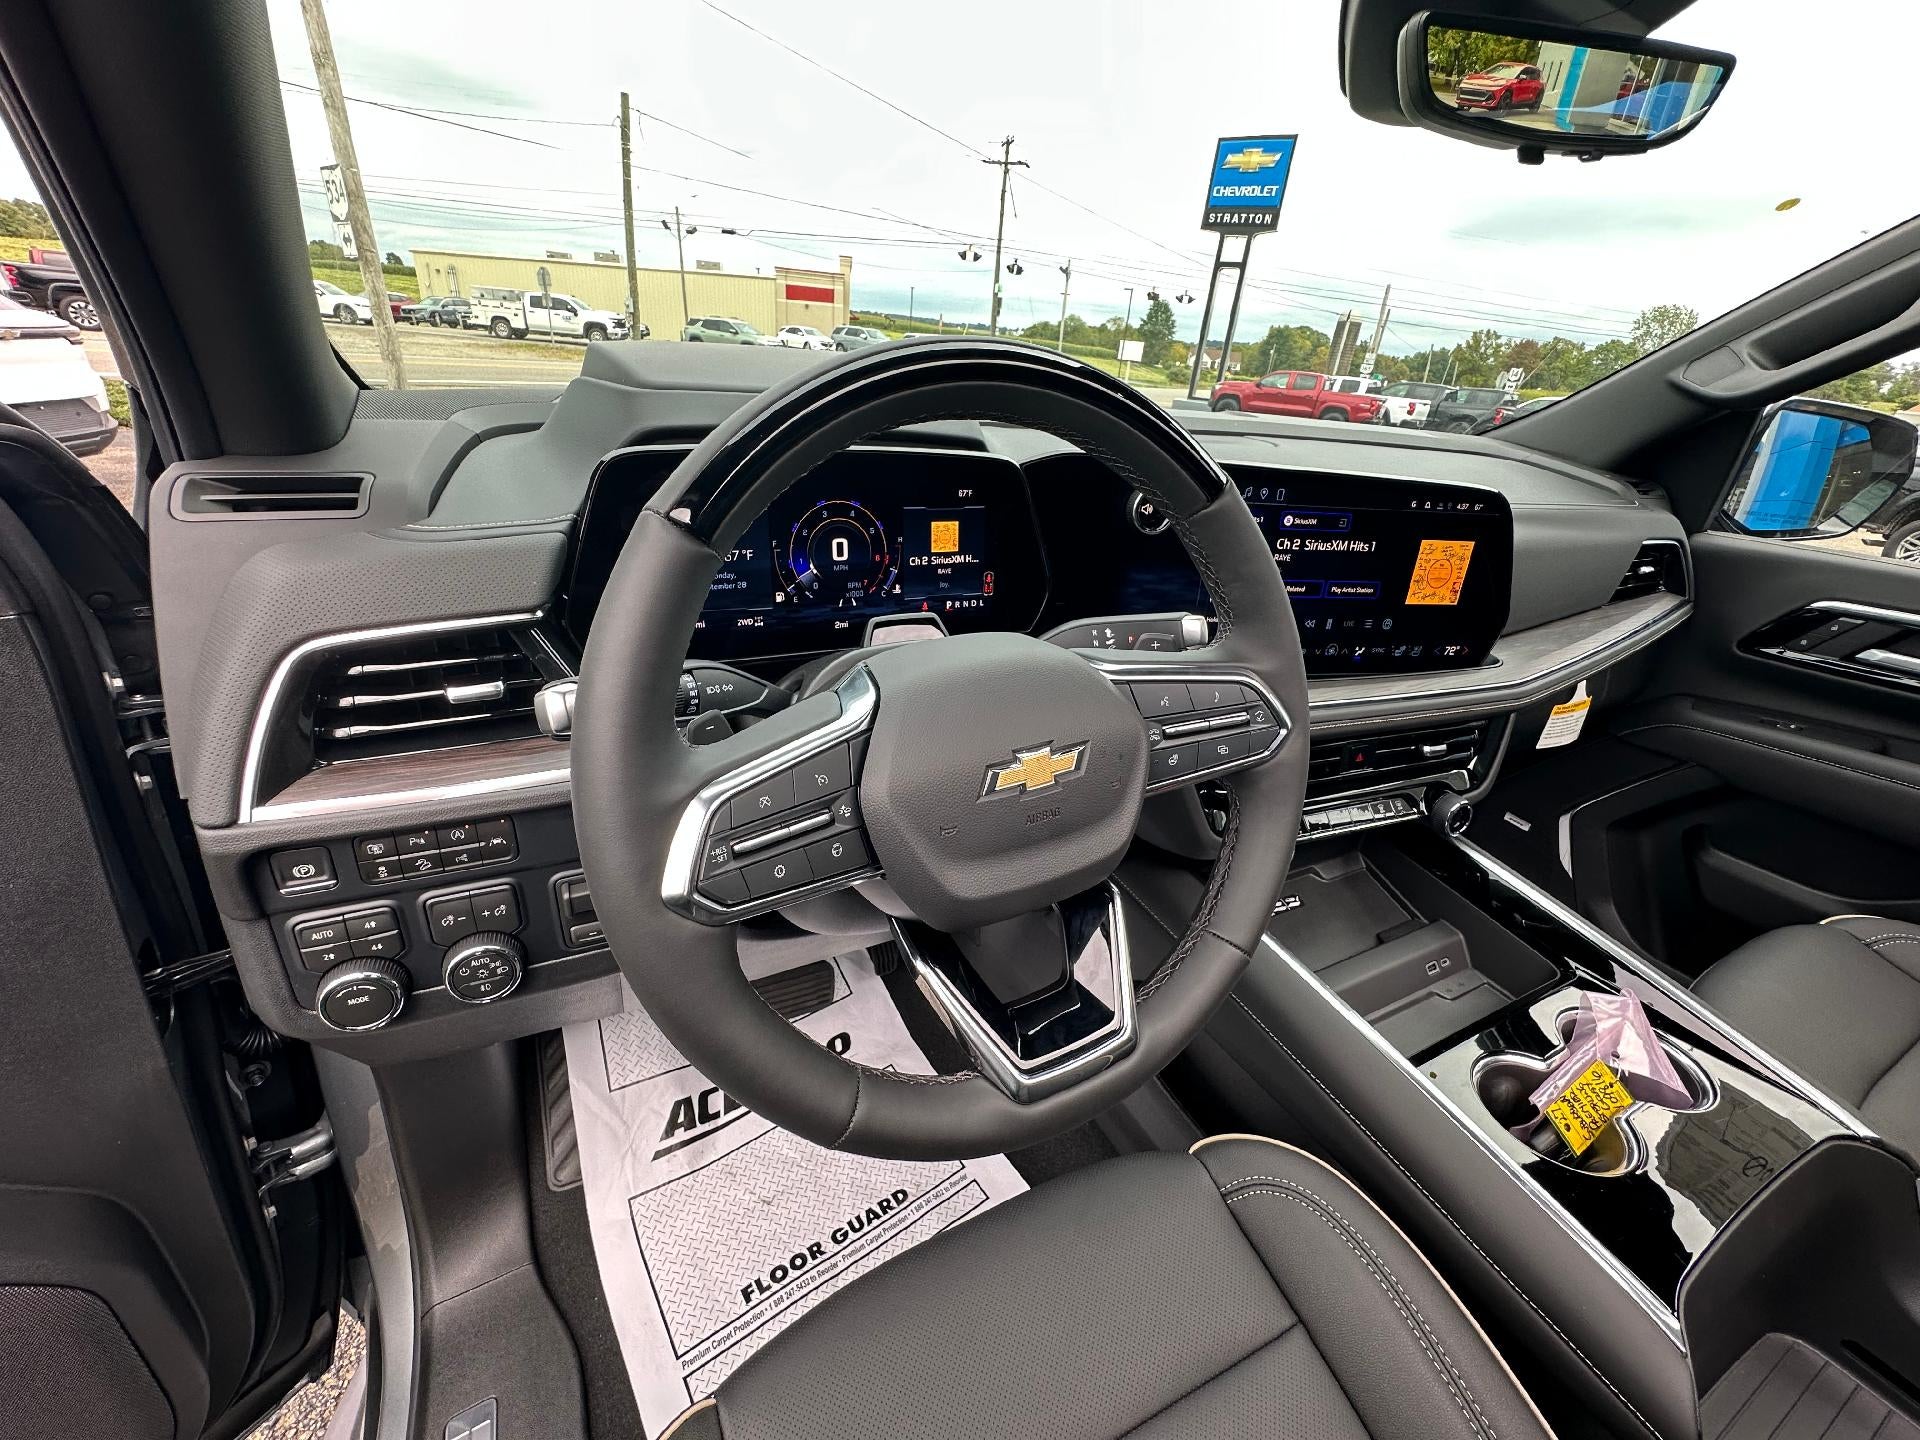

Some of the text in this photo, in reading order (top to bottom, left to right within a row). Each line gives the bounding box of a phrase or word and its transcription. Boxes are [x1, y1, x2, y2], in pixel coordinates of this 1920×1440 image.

[325, 179, 346, 205] 534
[1212, 185, 1280, 197] CHEVROLET
[1208, 213, 1273, 225] STRATTON
[822, 510, 828, 518] 3
[831, 537, 849, 562] 0
[1276, 538, 1377, 552] Ch 2 SiriusXM Hits 1
[909, 556, 921, 566] Ch
[921, 556, 929, 566] 2
[930, 554, 965, 565] SiriusXM
[737, 581, 747, 589] 28
[847, 581, 862, 590] RPM
[1330, 586, 1341, 594] Play
[737, 618, 754, 627] 2WD
[1025, 807, 1062, 827] AIRBAG
[311, 929, 334, 941] AUTO
[470, 957, 491, 967] AUTO
[347, 995, 370, 1006] MODE
[740, 1188, 909, 1305] FLOOR GUARD
[681, 1343, 712, 1371] Premium
[711, 1330, 734, 1351] Carpet
[733, 1310, 766, 1336] Protection
[785, 1277, 810, 1301] 247-5432
[817, 1261, 840, 1279] Reorder
[841, 1238, 867, 1263] Premium
[865, 1229, 884, 1247] Carpet
[881, 1213, 910, 1236] Protection
[948, 1172, 969, 1189] Reorder
